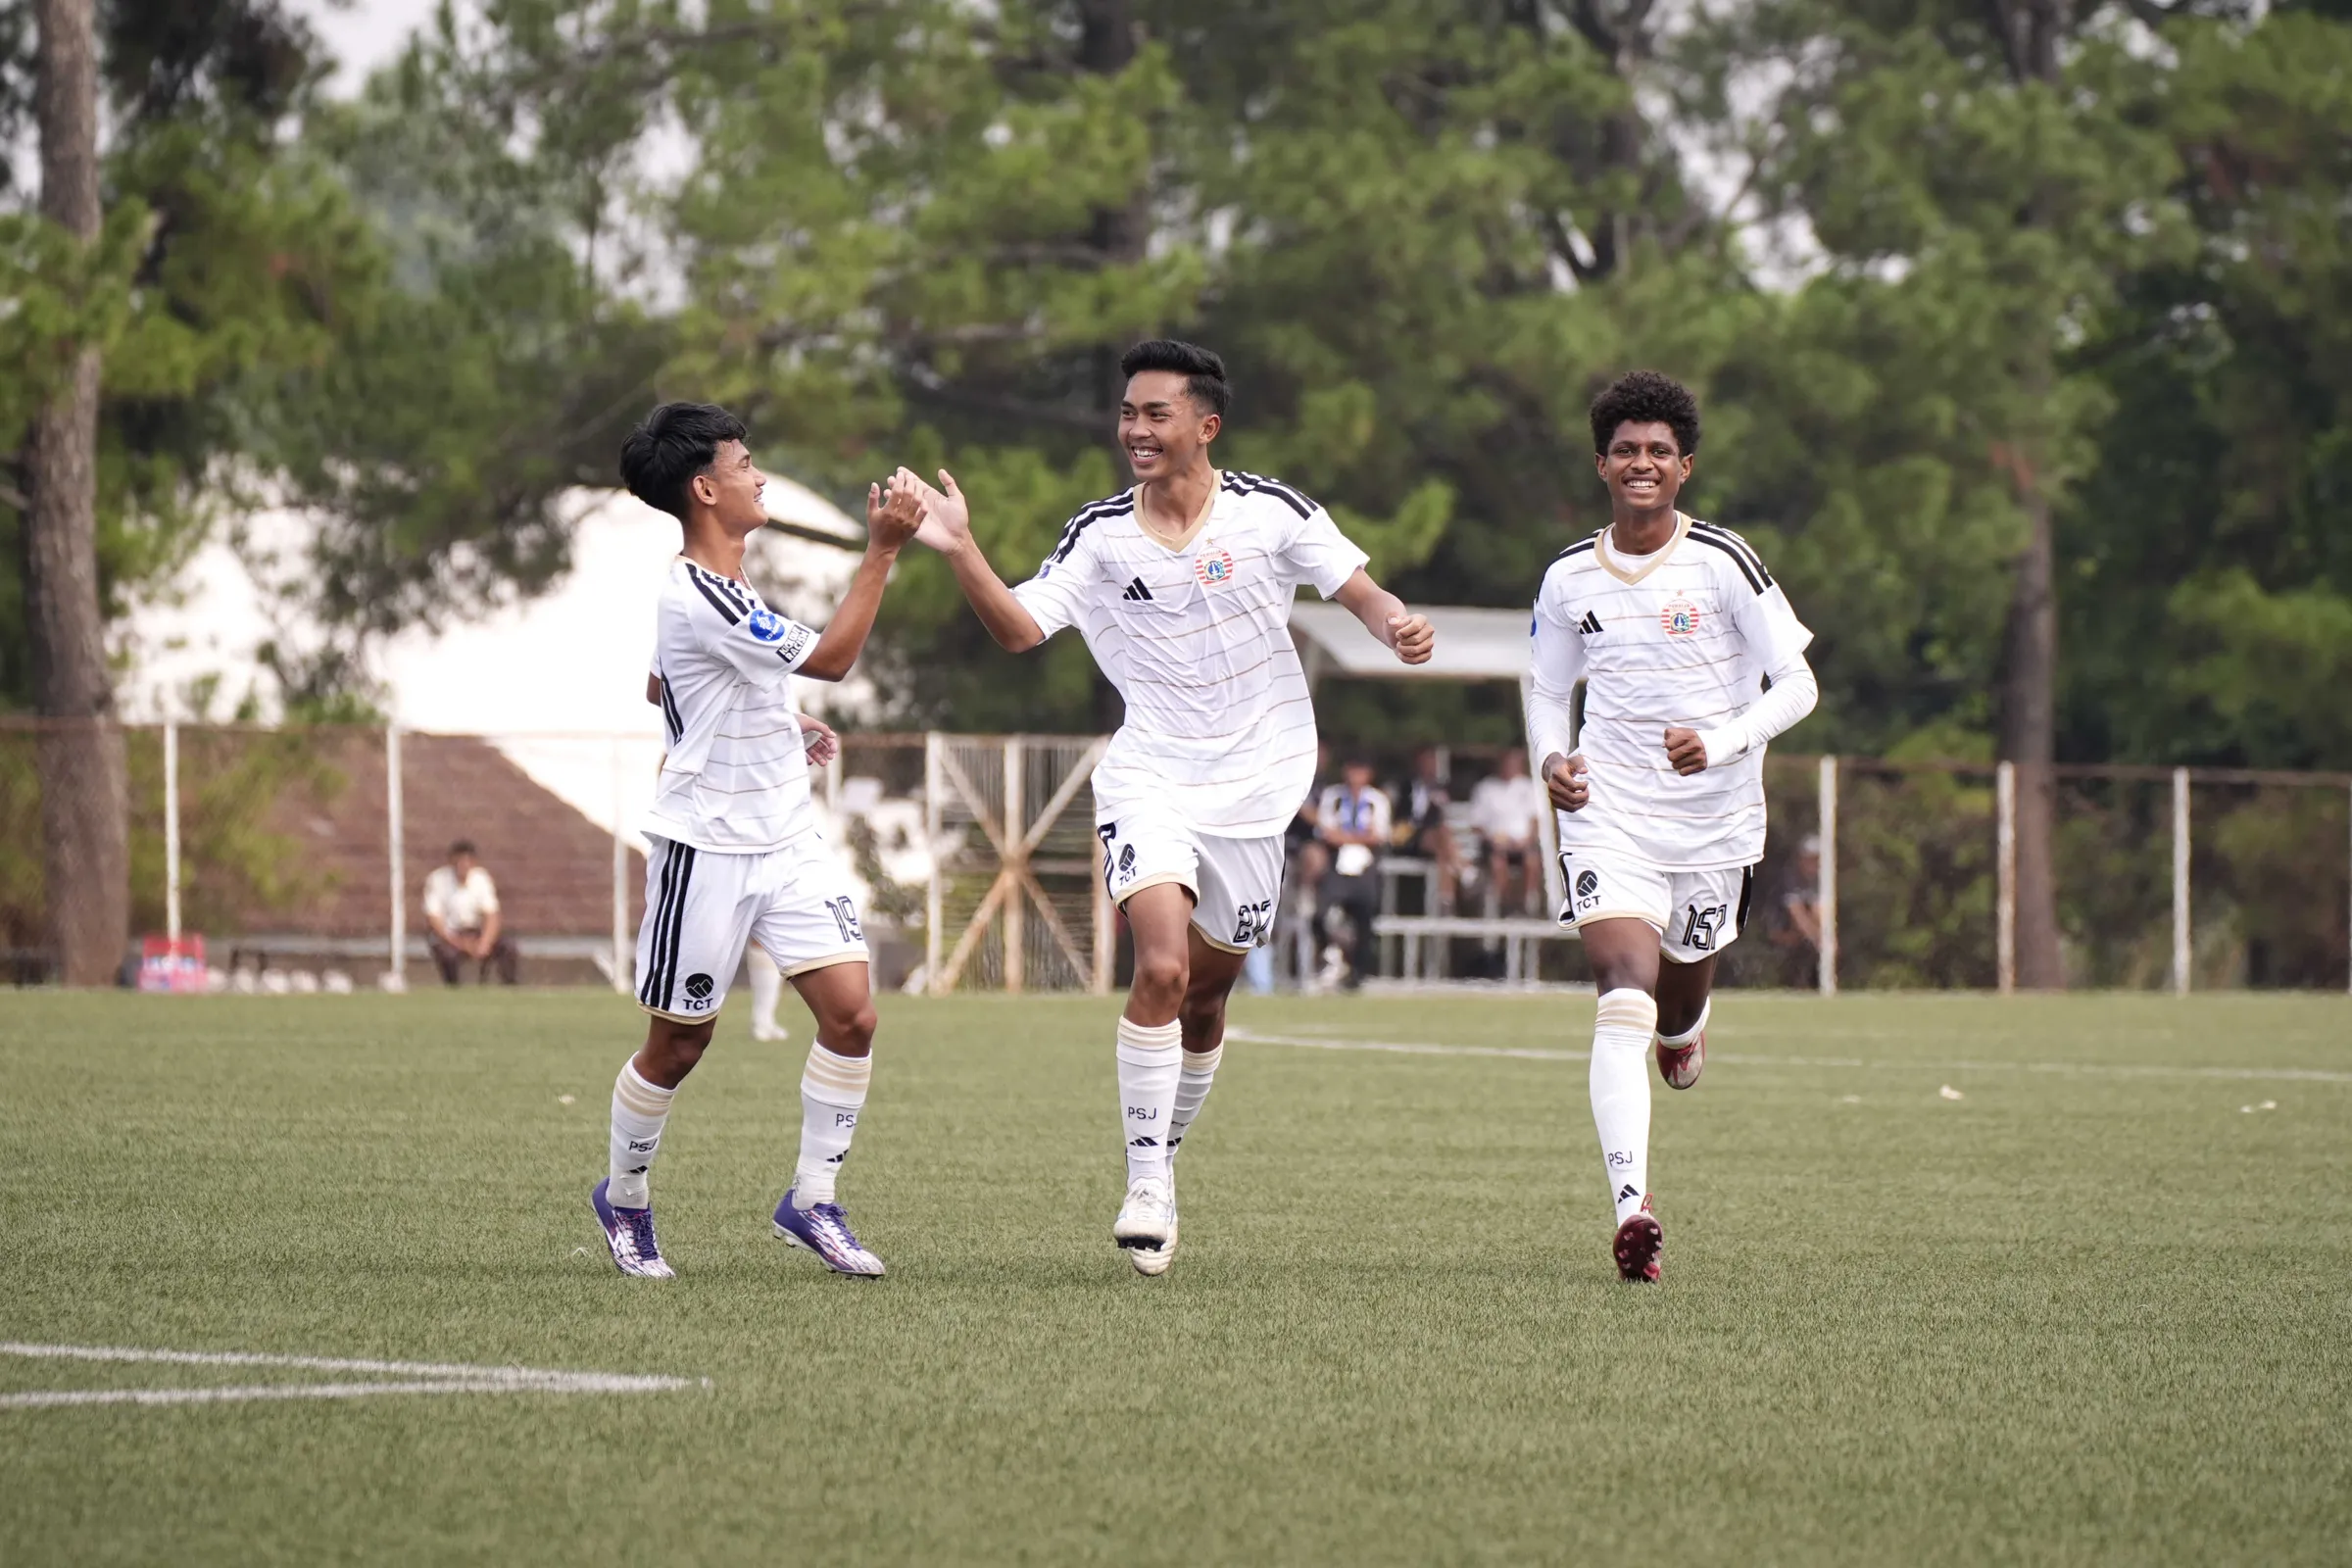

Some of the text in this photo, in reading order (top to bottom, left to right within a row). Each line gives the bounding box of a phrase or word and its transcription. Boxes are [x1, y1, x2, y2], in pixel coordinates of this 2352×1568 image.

[784, 631, 808, 661] RACISM
[1119, 865, 1137, 886] TCT
[1577, 895, 1601, 912] TCT
[824, 896, 862, 943] 19
[1682, 904, 1727, 951] 157
[682, 998, 713, 1010] TCT
[836, 1113, 857, 1128] PS
[1128, 1106, 1156, 1120] PSJ
[629, 1138, 658, 1152] PSJ
[1608, 1151, 1633, 1167] PSJ
